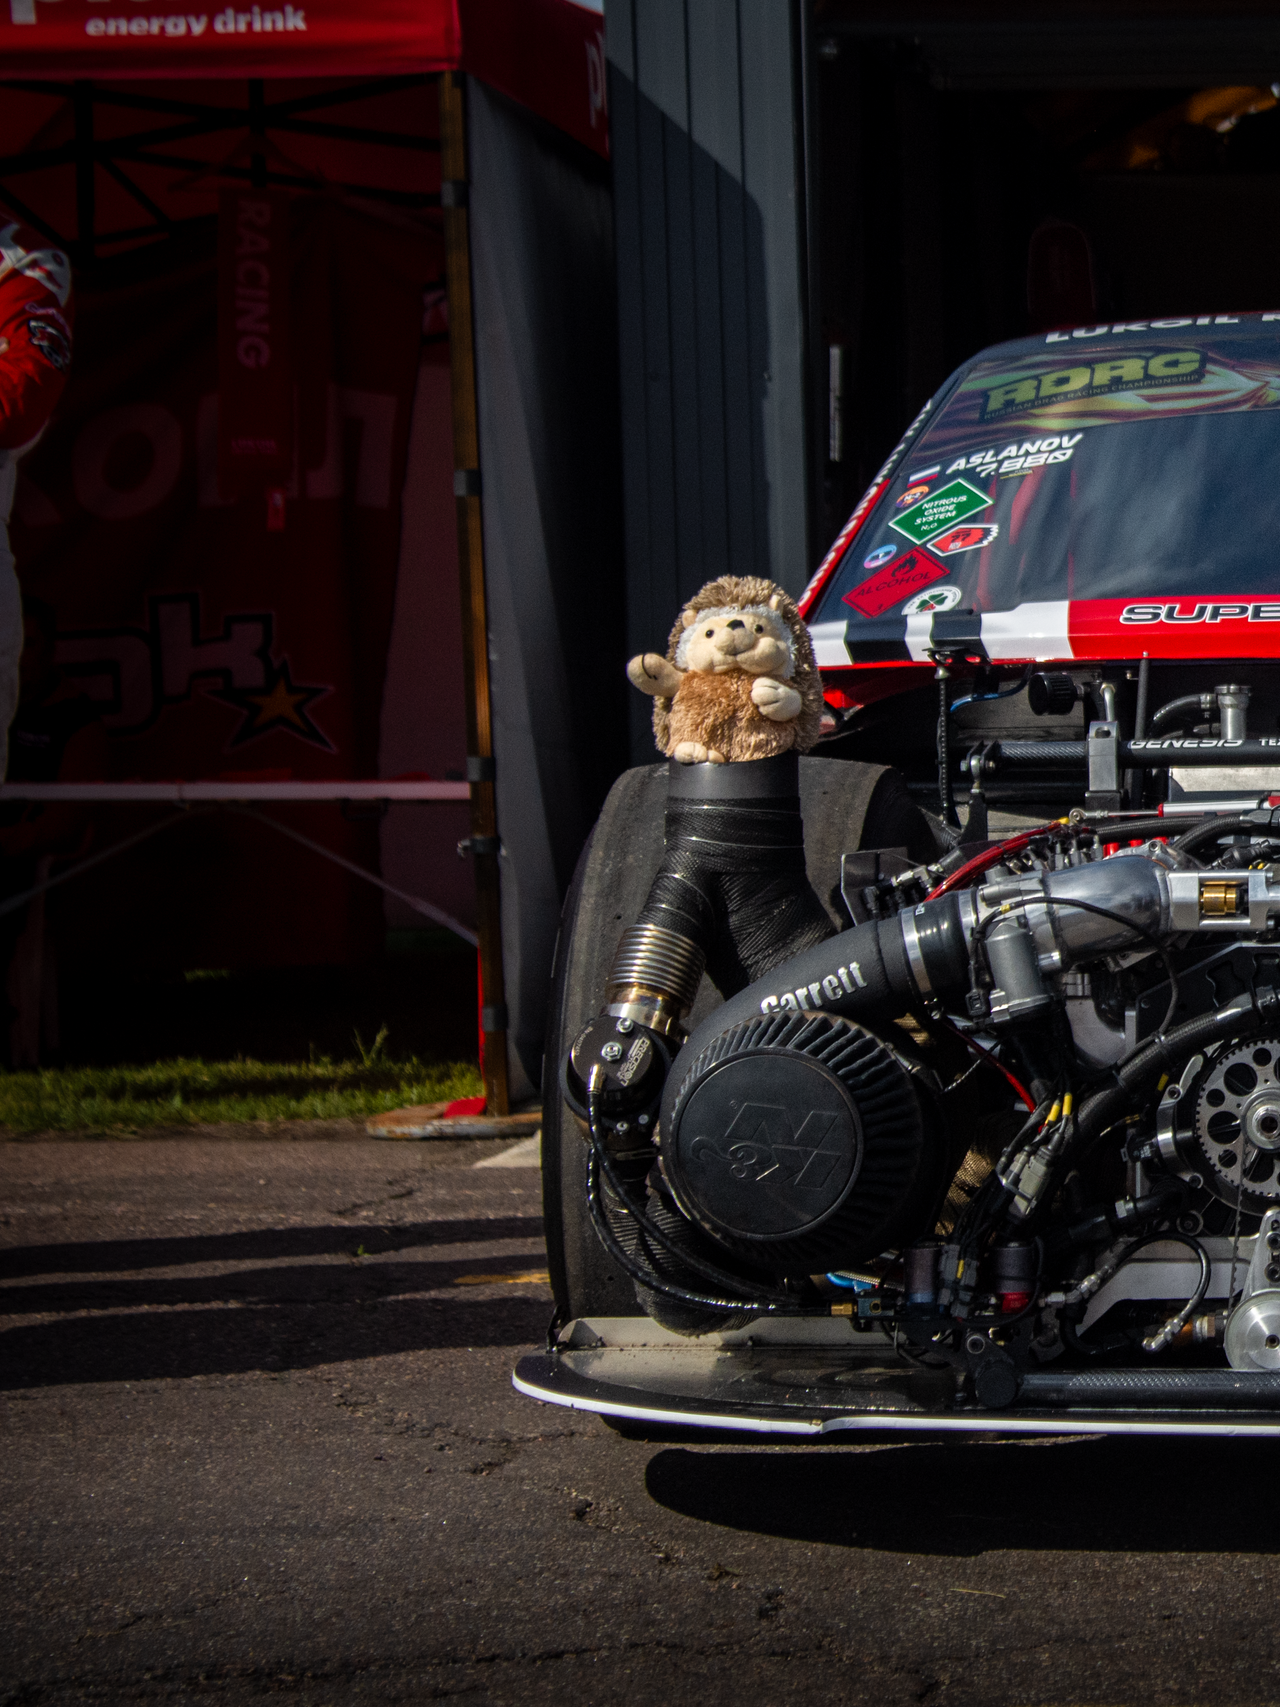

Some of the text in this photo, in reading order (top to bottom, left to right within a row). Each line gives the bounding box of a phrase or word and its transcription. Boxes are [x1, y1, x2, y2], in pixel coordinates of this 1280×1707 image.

[85, 13, 209, 38] energy
[213, 3, 308, 34] drink
[236, 200, 271, 370] RACING
[1046, 315, 1240, 343] LUKOIL
[984, 374, 1199, 420] RUSSIAN DRAG RACING CHAMPIONSHIP
[986, 351, 1201, 411] RDRC
[945, 432, 1084, 475] ASLANOV
[914, 510, 957, 526] SYSTEM
[921, 495, 968, 510] NITROUS
[924, 504, 957, 517] OXIDE
[760, 961, 868, 1014] Garrett
